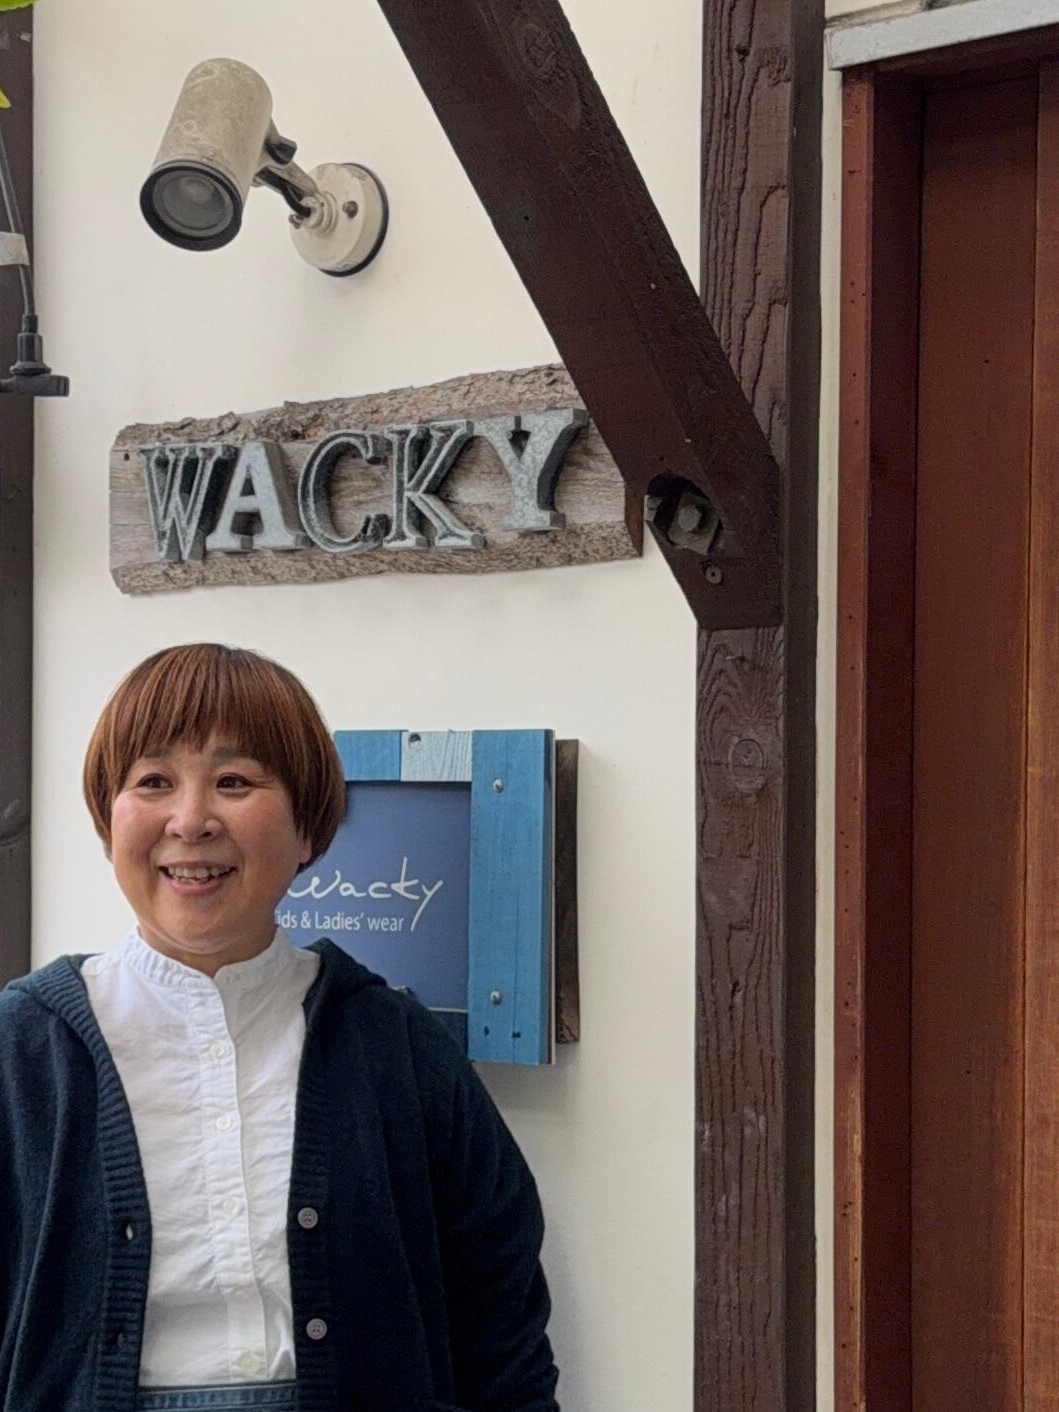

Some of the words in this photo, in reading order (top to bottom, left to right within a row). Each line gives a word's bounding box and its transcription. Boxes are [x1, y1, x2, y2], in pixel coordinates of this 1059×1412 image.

[139, 408, 588, 561] WACKY
[275, 909, 298, 929] ids
[300, 910, 312, 929] &
[367, 916, 404, 932] wear
